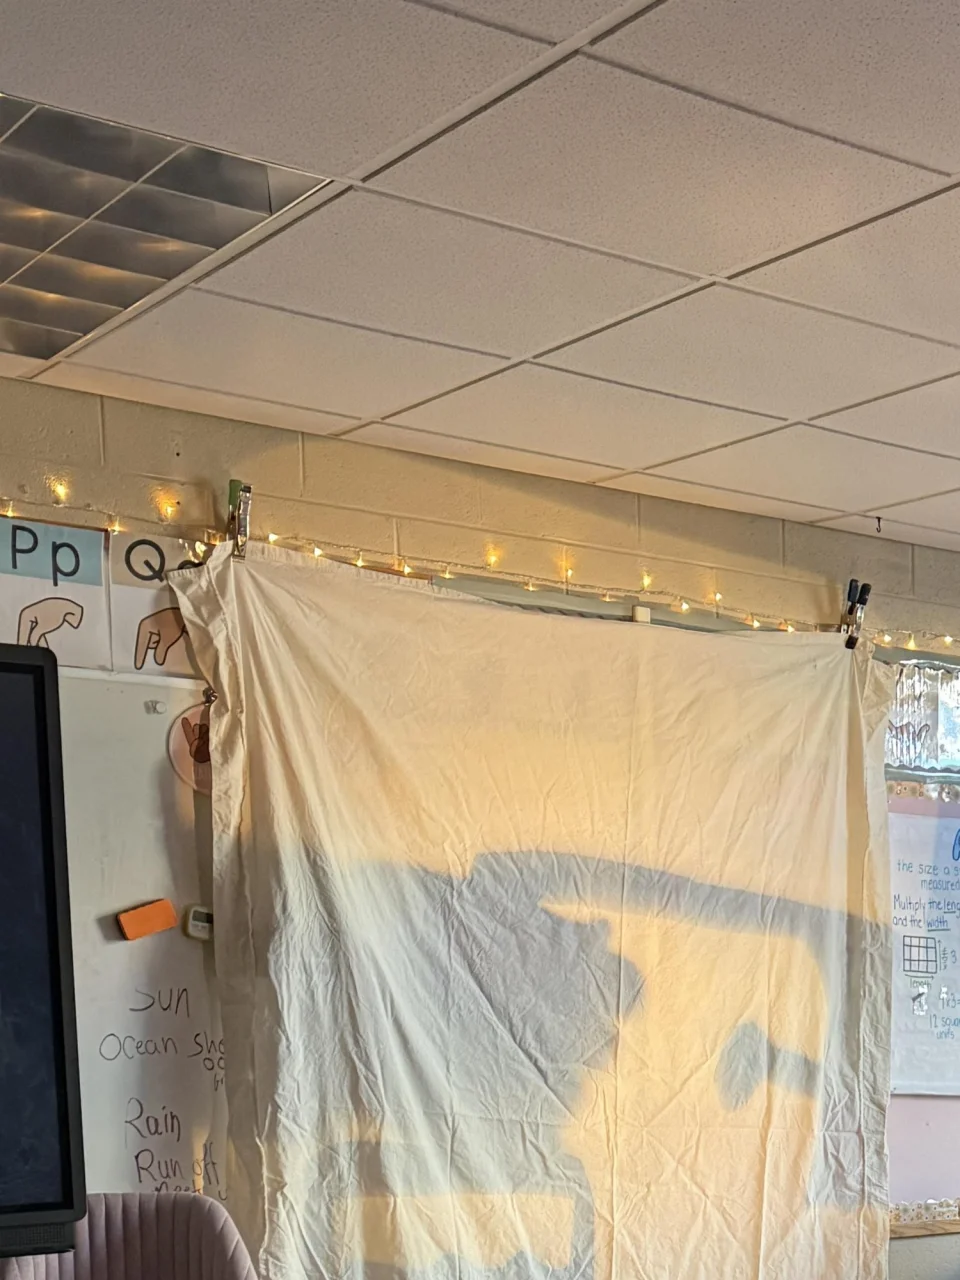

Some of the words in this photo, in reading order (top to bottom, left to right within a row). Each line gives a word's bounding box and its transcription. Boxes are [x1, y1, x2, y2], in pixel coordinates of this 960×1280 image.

[12, 525, 80, 587] Pp
[897, 860, 913, 875] the
[918, 864, 938, 875] size
[943, 866, 950, 875] a
[921, 879, 960, 891] measured
[893, 895, 925, 917] Multiply
[928, 898, 943, 911] the
[893, 916, 907, 927] and
[909, 916, 922, 928] the
[927, 917, 949, 928] width
[129, 987, 190, 1017] Sun
[99, 1032, 178, 1061] Ocean
[124, 1097, 181, 1147] Rain
[135, 1148, 184, 1183] Run
[192, 1142, 219, 1185] off
